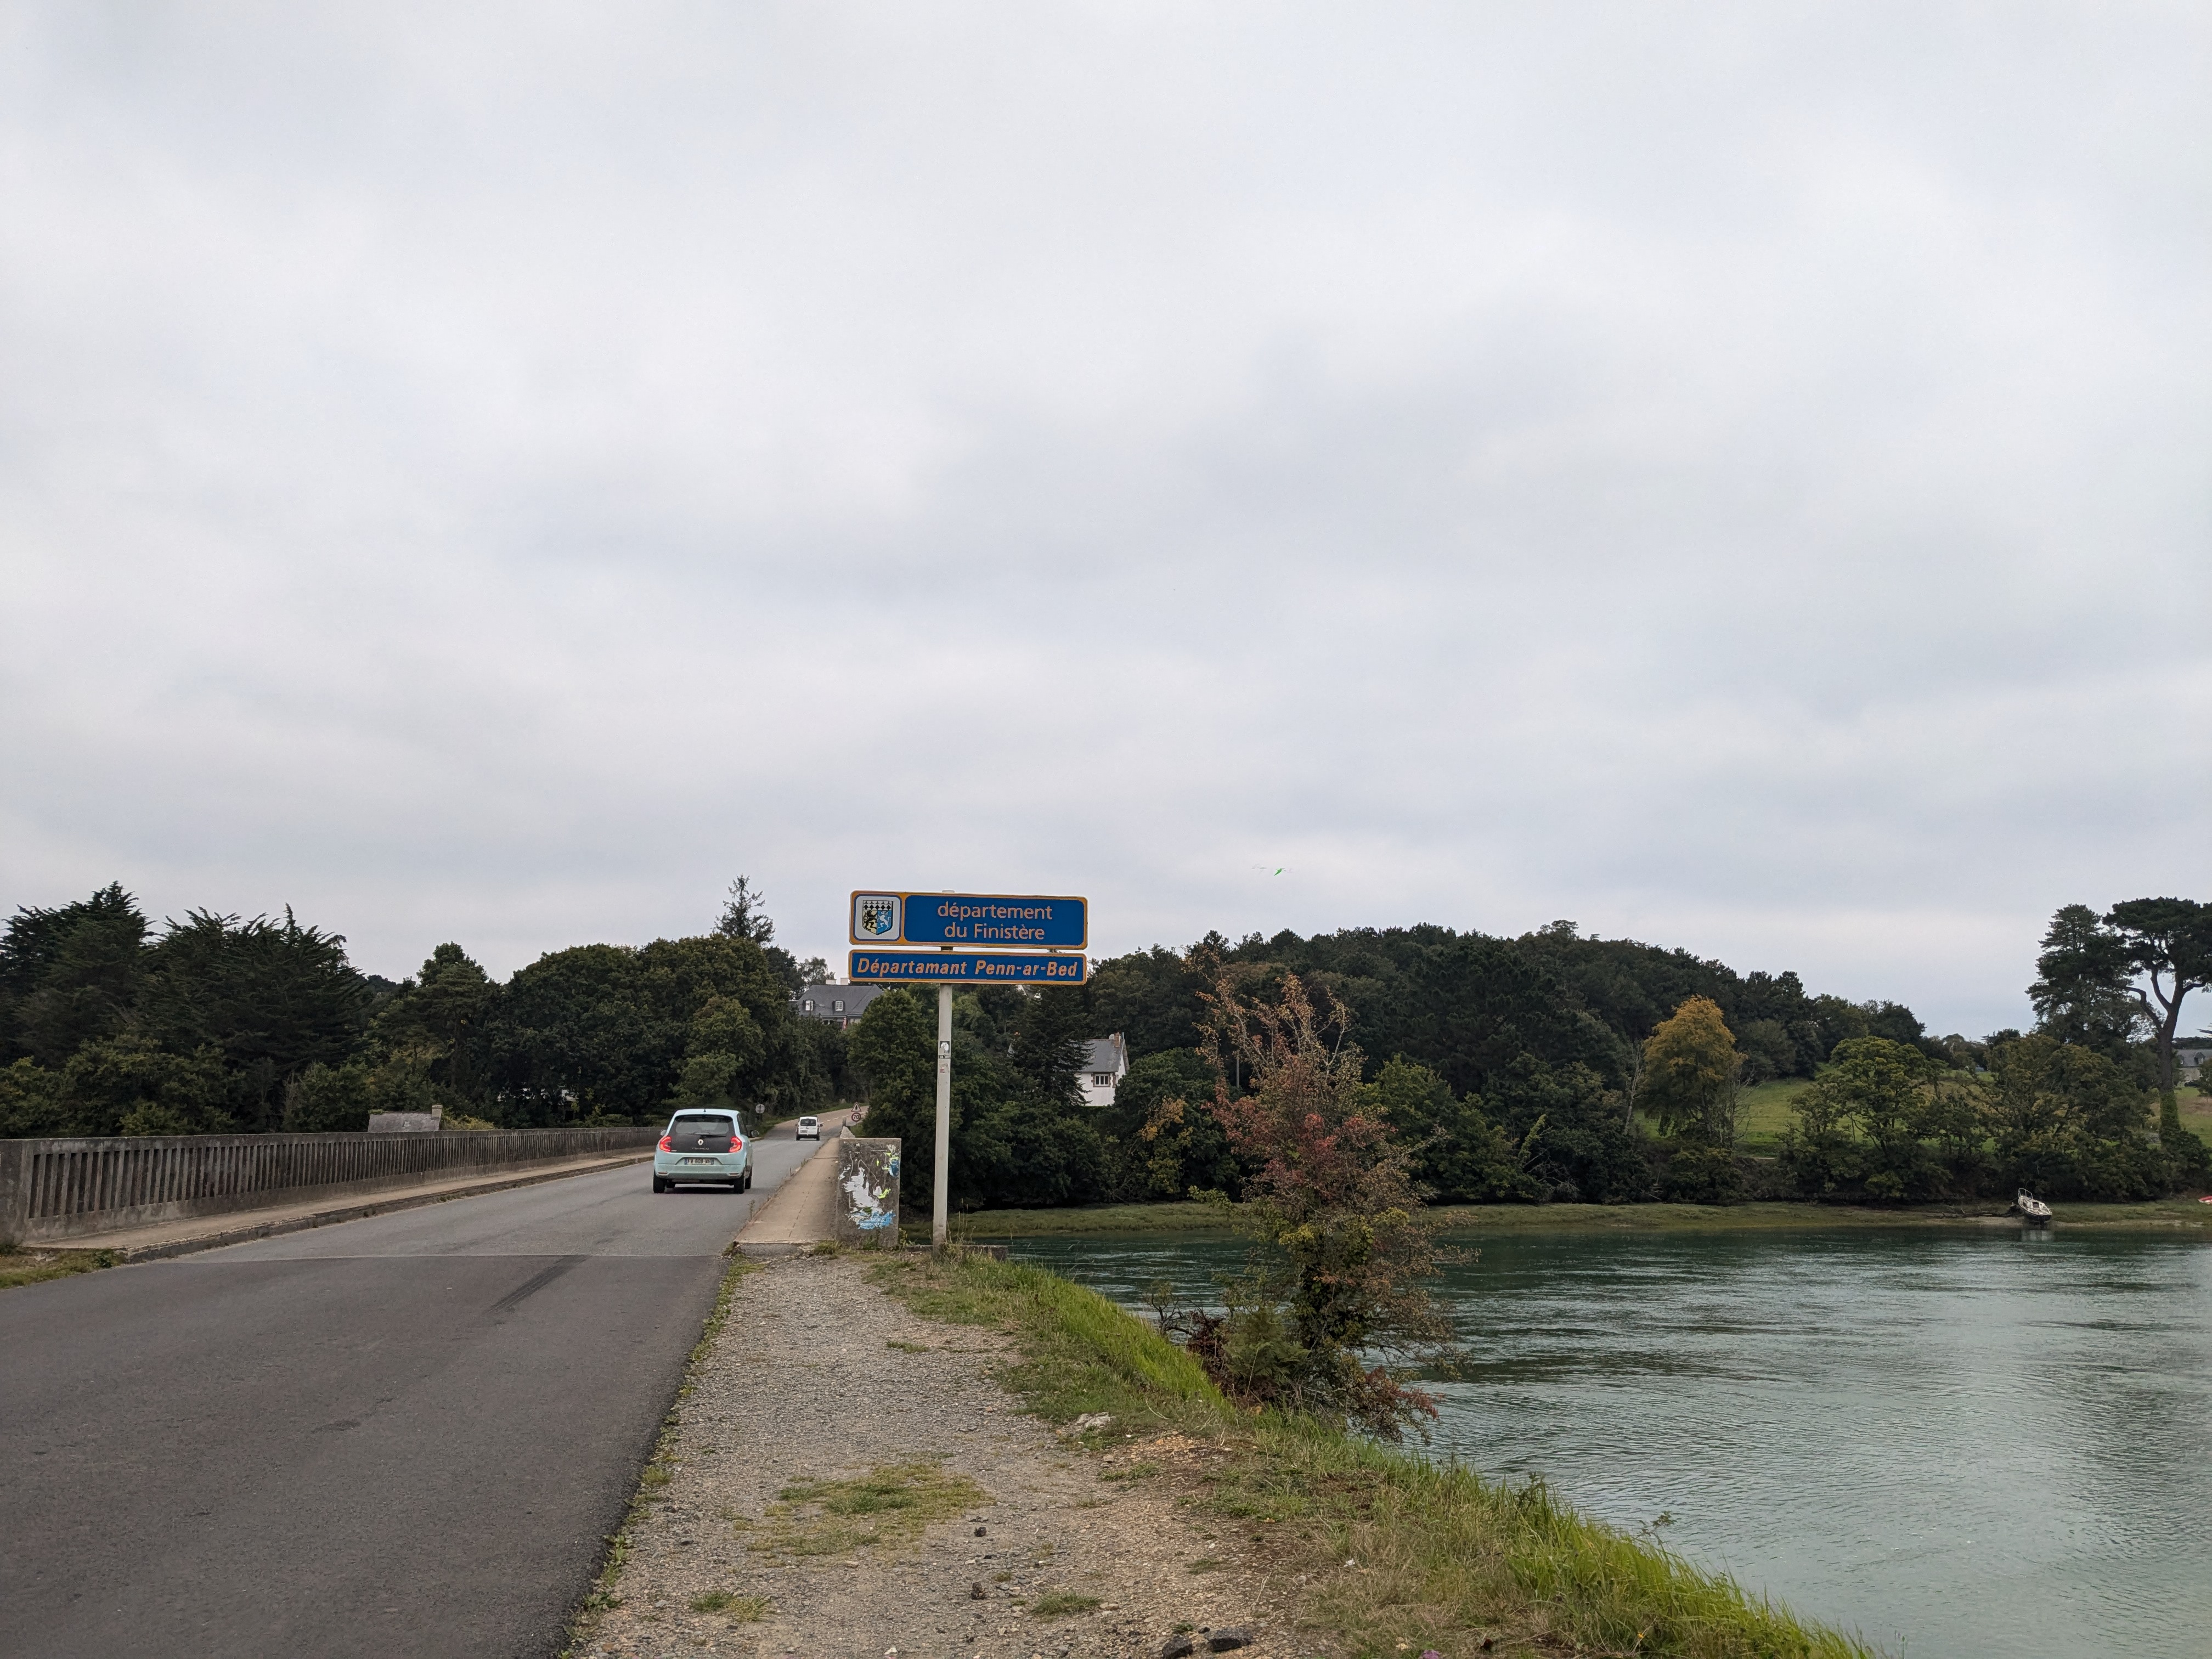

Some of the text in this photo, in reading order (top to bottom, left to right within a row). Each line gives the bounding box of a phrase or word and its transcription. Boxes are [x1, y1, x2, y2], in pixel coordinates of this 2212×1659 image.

[938, 901, 1052, 921] département
[945, 922, 1045, 940] du Finistère
[857, 958, 1077, 977] Départamant Penn-ar-Bed
